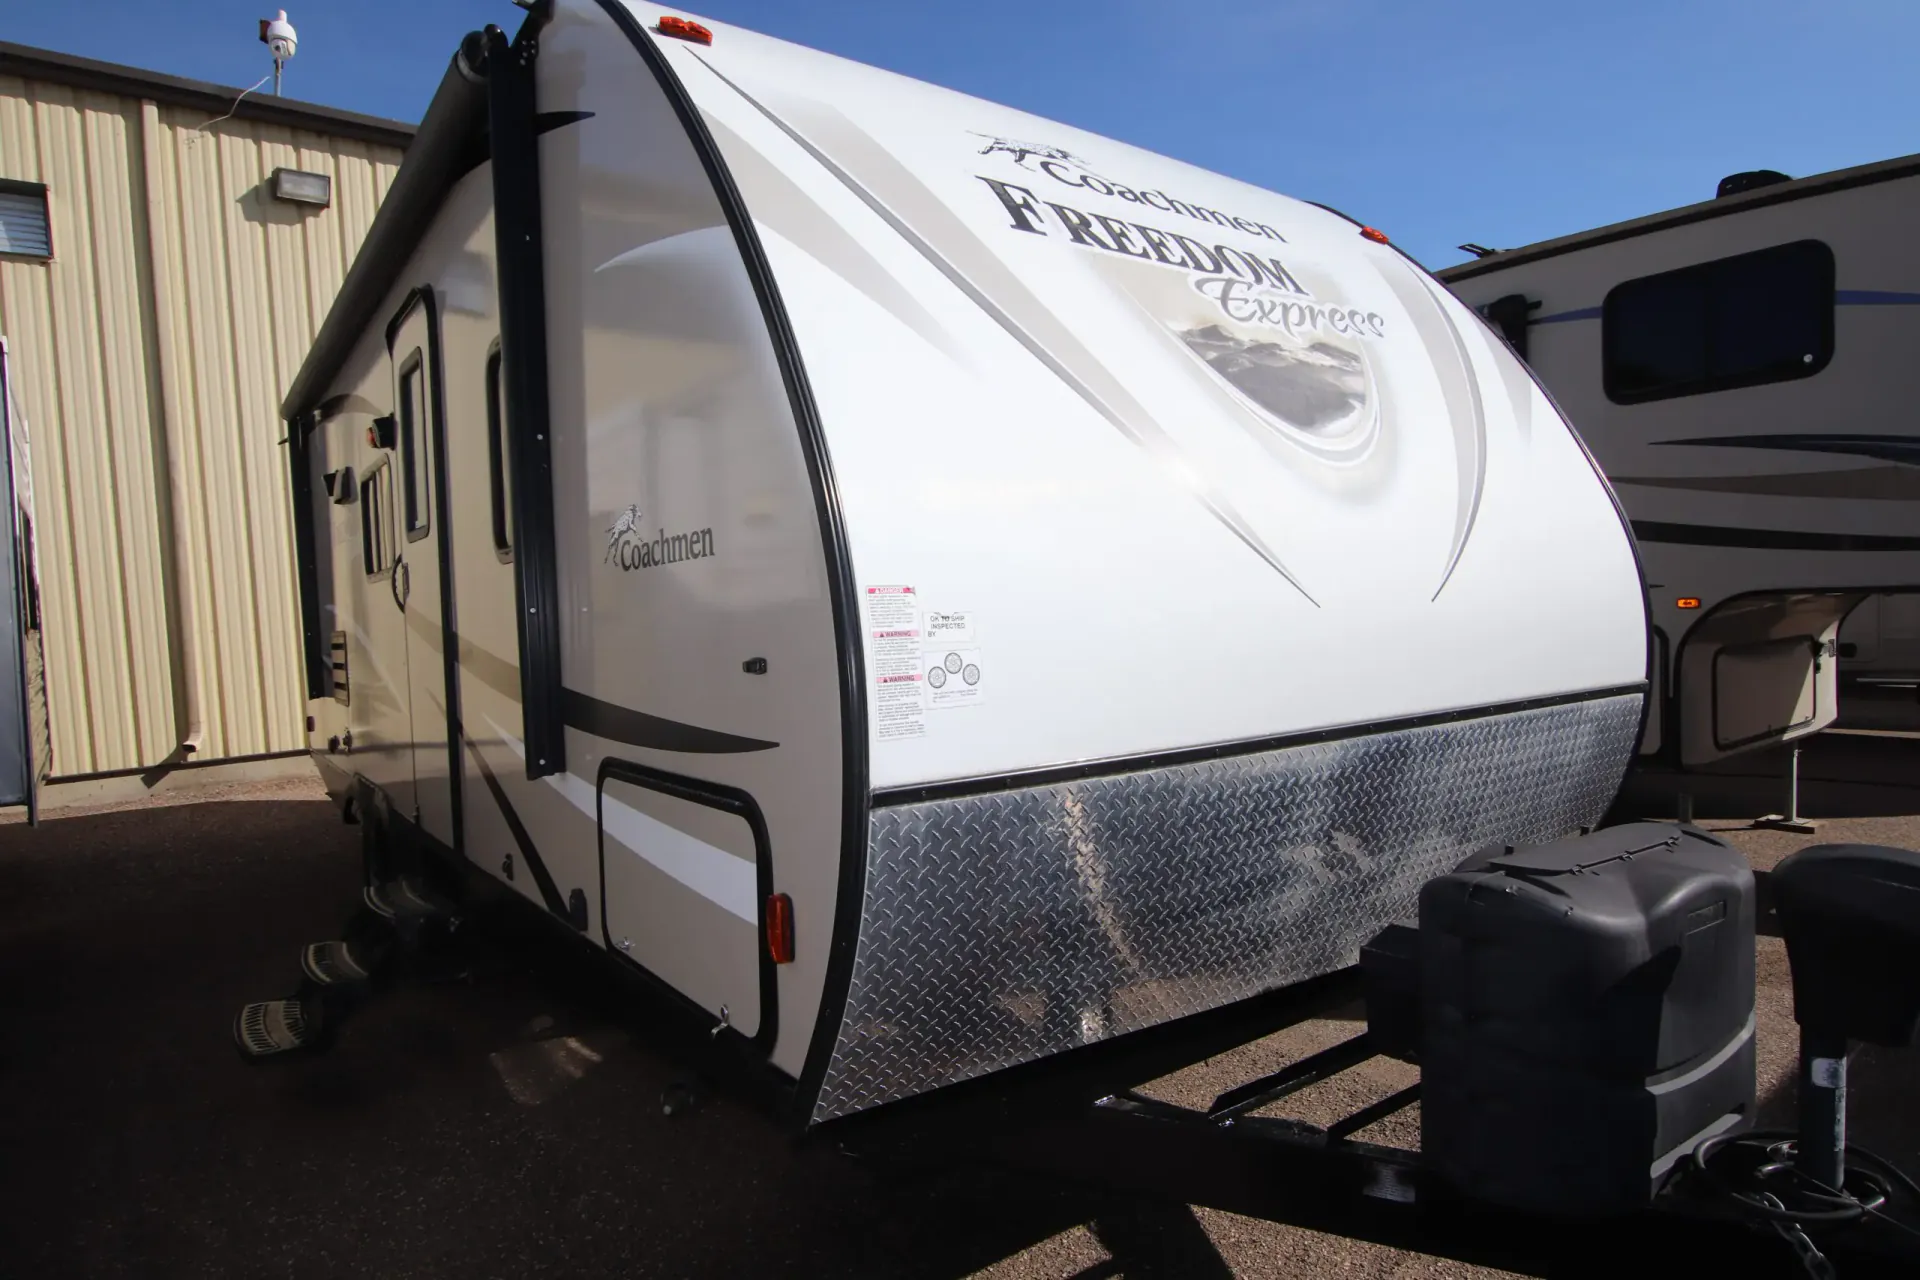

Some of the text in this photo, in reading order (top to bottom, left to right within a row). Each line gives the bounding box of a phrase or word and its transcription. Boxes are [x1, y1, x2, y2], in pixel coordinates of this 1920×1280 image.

[1040, 161, 1290, 244] Coachmen
[975, 175, 1309, 296] FREEDOM
[1195, 277, 1385, 339] Express
[621, 527, 715, 572] Coachmen
[927, 630, 936, 638] BY
[930, 622, 966, 630] INSPECTED
[889, 675, 915, 683] WARNING
